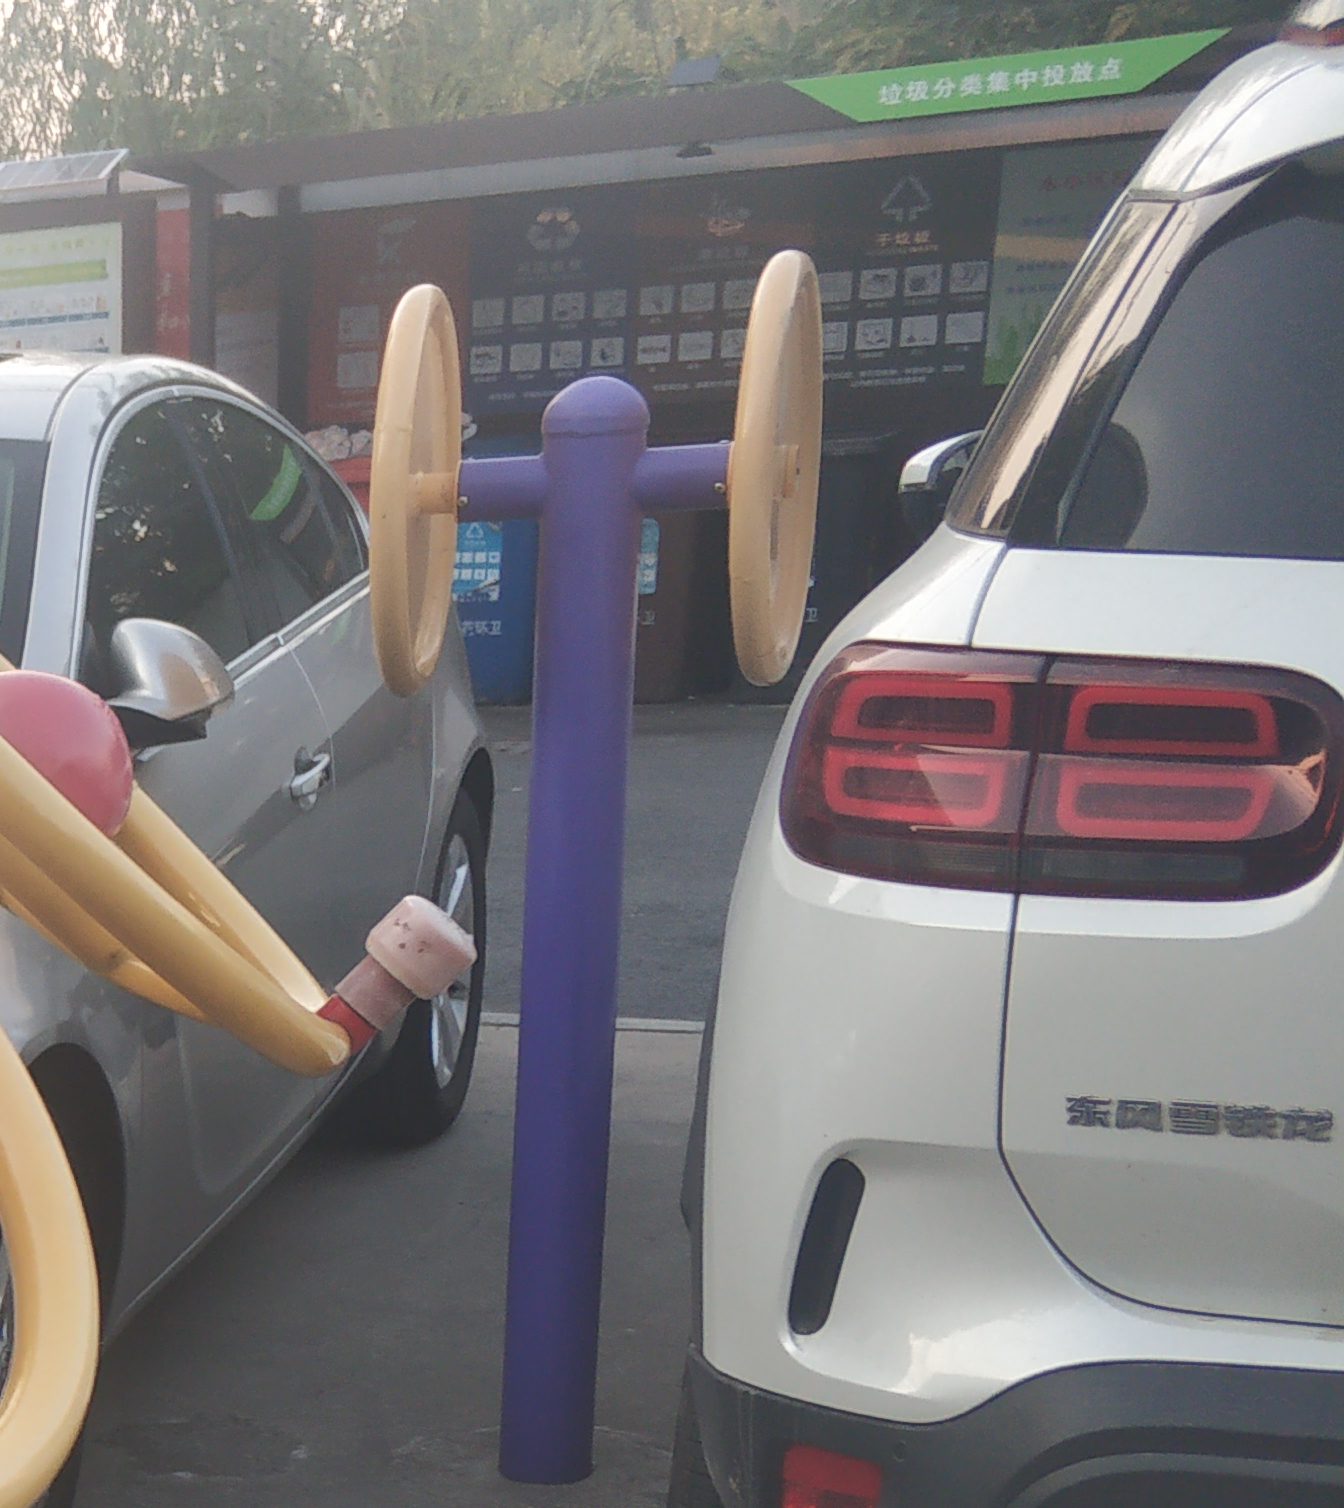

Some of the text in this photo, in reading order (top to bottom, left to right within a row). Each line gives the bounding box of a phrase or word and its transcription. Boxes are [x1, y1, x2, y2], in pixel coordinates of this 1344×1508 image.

[878, 57, 1124, 105] 垃圾分类集中投放点
[1065, 1094, 1334, 1143] 东风雪铁龙
